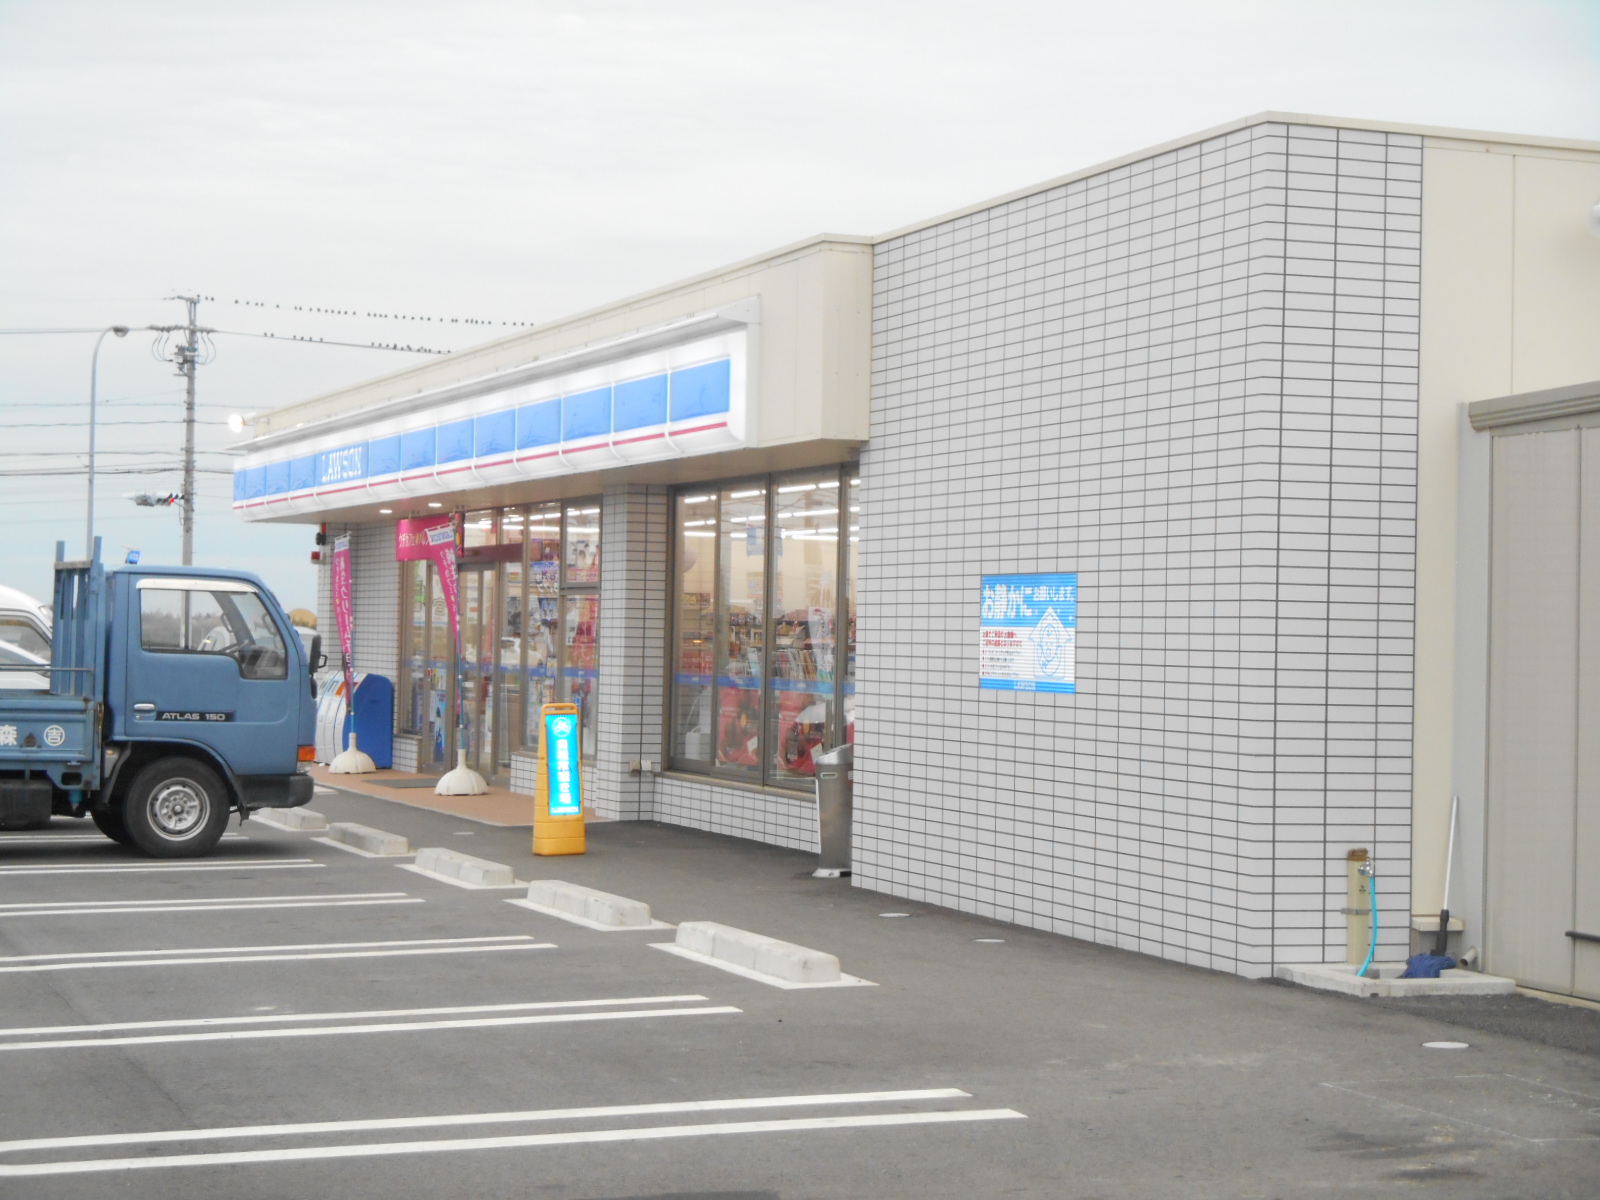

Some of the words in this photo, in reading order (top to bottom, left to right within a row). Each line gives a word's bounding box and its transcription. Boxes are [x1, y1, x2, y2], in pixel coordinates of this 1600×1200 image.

[321, 446, 363, 484] LAWSON
[982, 583, 1033, 619] お静かに
[162, 712, 200, 721] ATLAS
[205, 713, 225, 721] 150
